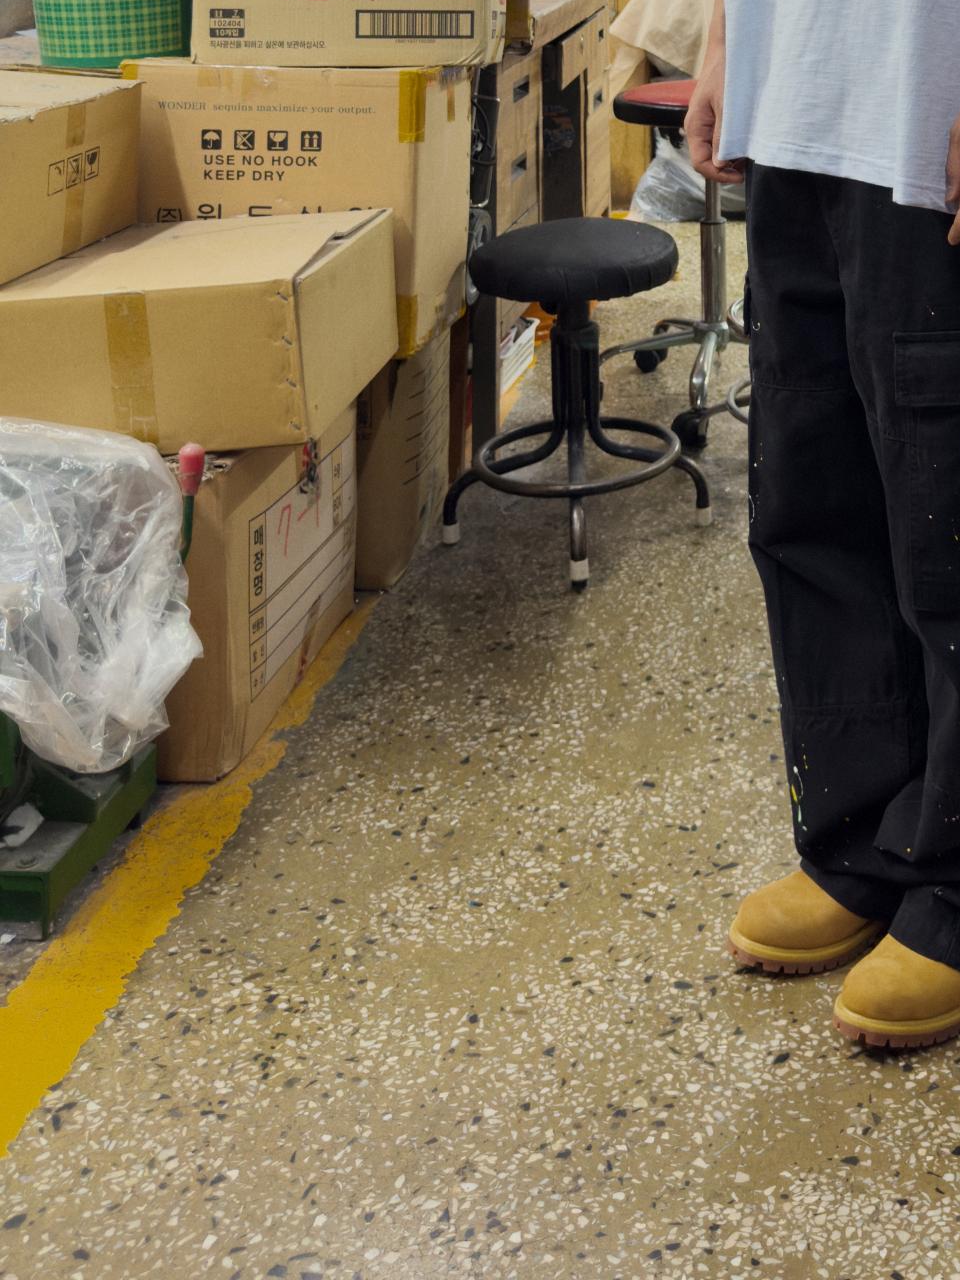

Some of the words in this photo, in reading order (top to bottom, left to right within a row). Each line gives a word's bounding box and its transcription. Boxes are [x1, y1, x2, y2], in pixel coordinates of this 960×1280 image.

[158, 101, 207, 111] WONDER
[213, 102, 253, 112] sequins
[256, 103, 308, 113] maximize
[311, 105, 335, 114] your
[204, 155, 235, 165] USE
[242, 155, 265, 165] NO
[271, 156, 318, 167] HOOK
[203, 170, 245, 181] KEEP
[252, 170, 285, 181] DRY
